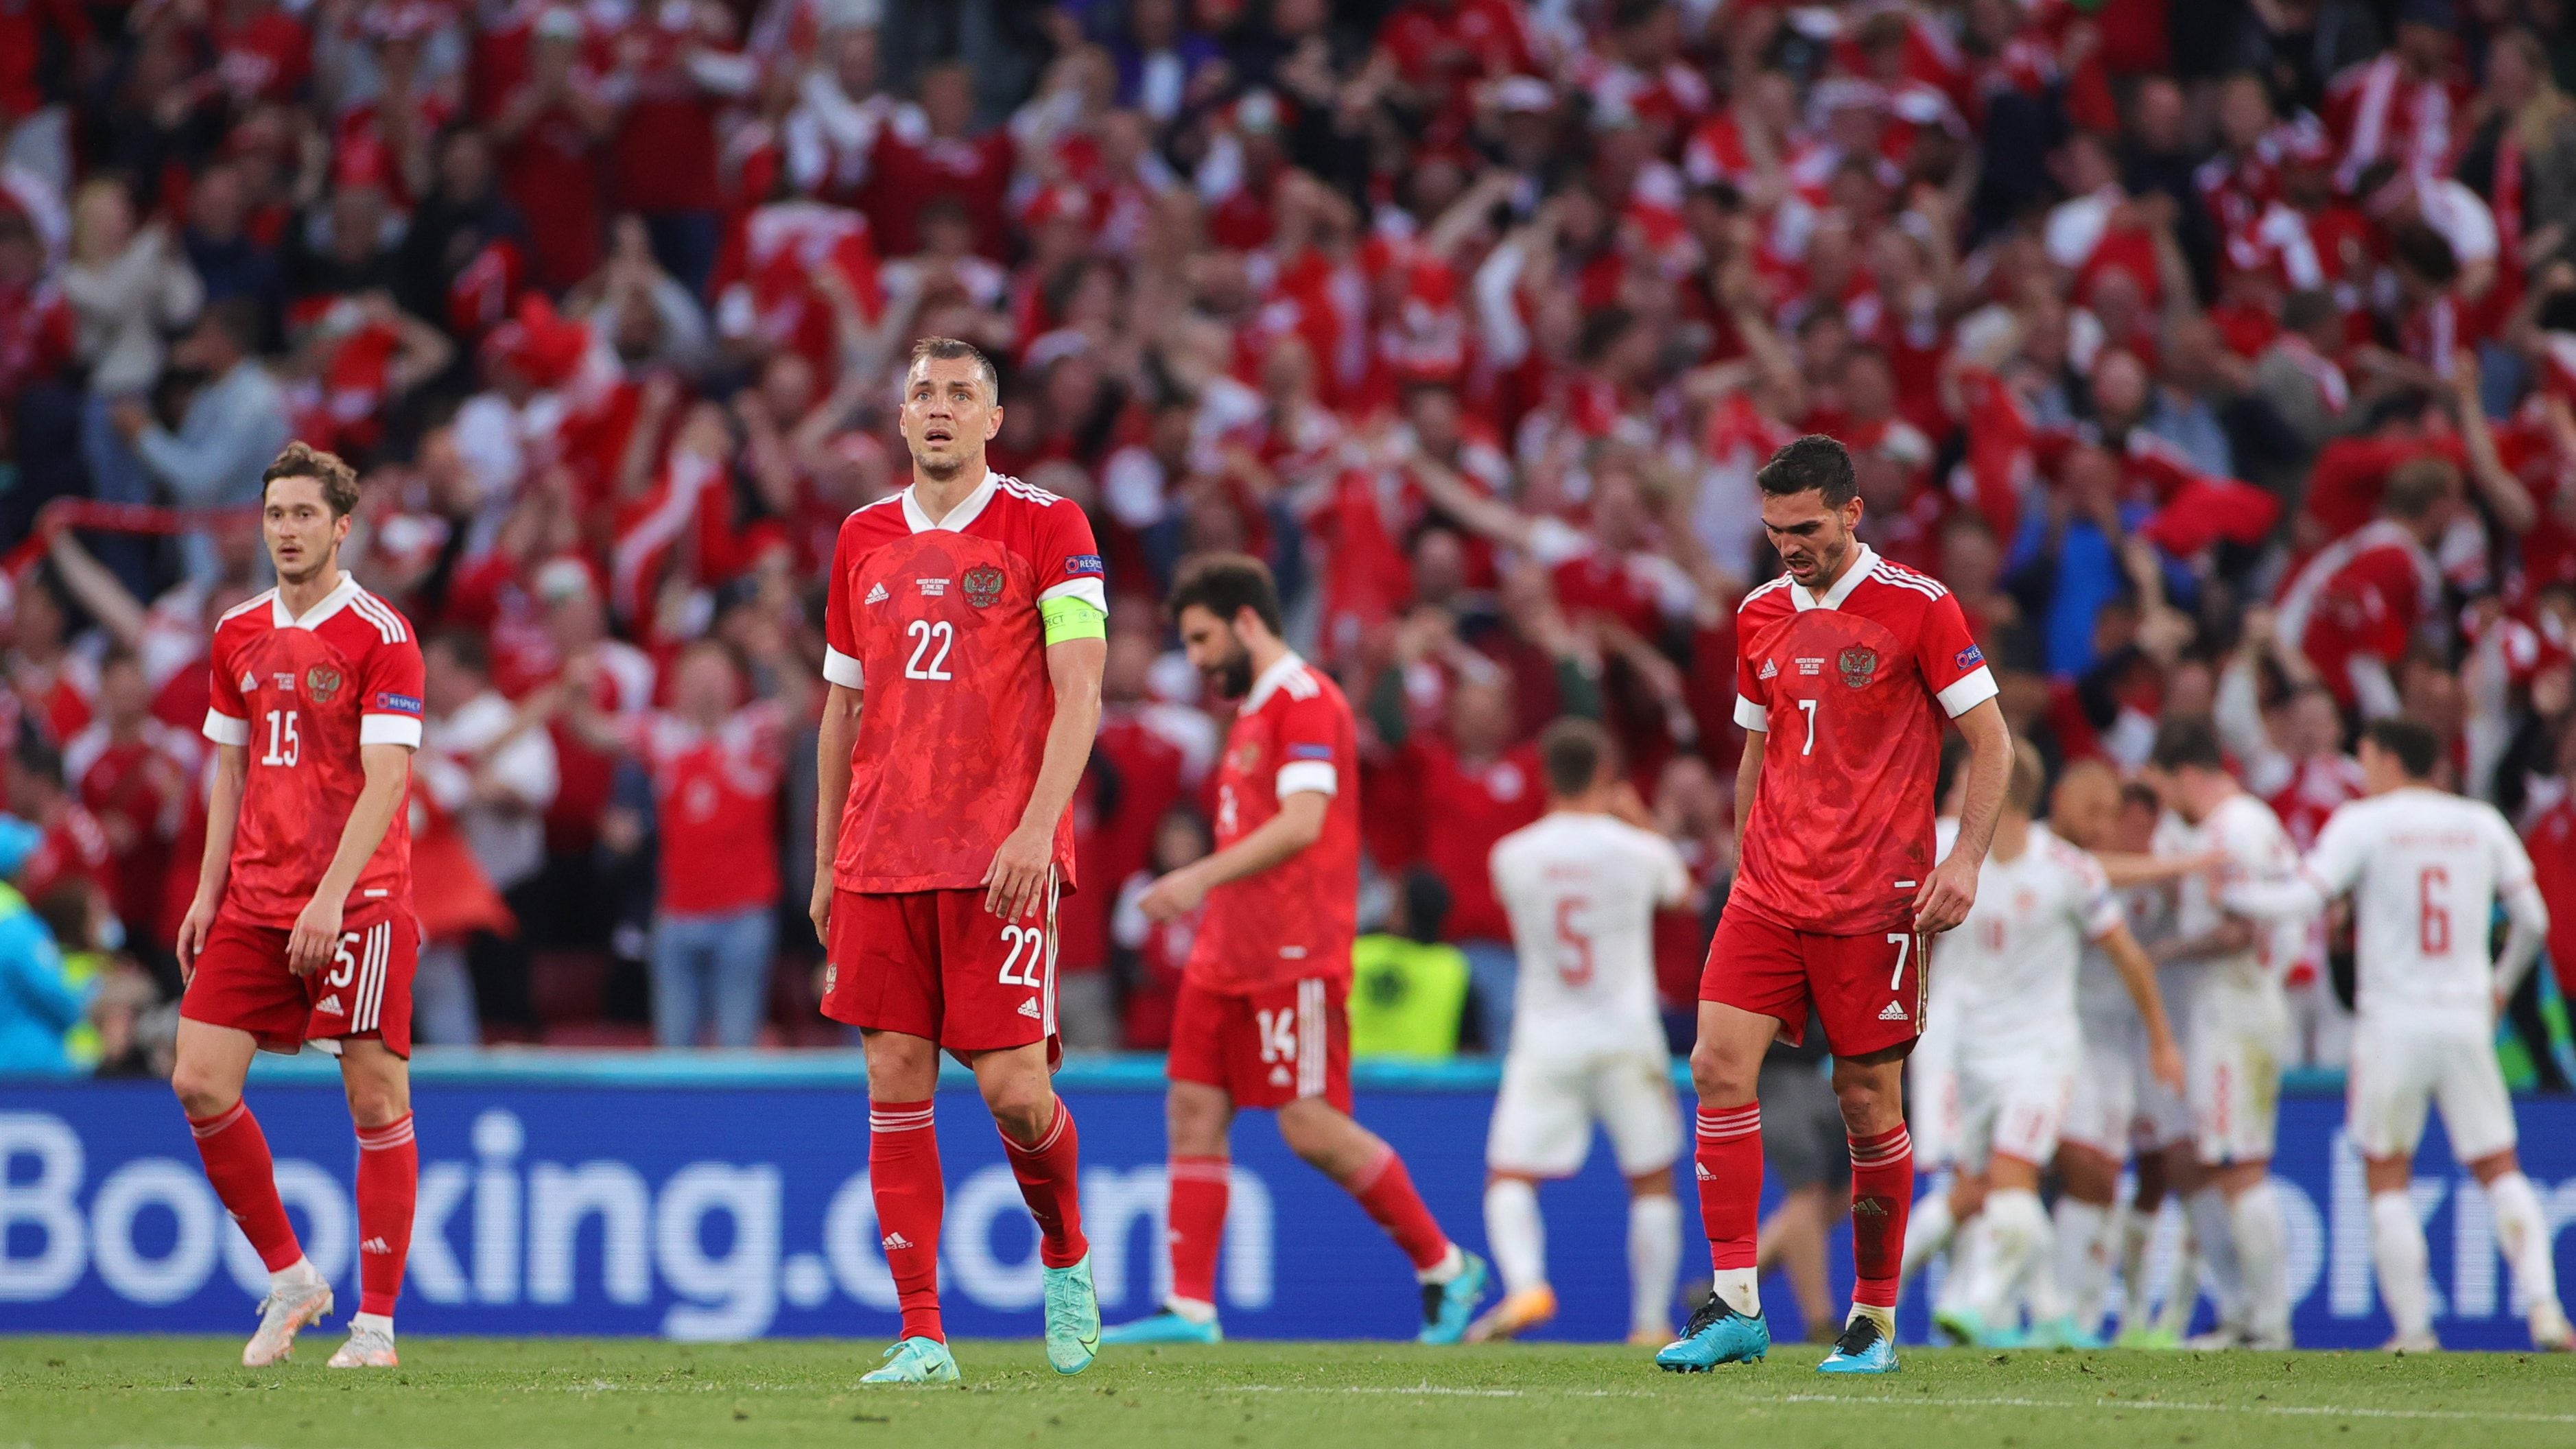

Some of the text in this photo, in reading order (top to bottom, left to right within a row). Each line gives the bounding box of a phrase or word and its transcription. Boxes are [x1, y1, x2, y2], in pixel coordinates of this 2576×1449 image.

[864, 592, 889, 605] adidas
[905, 620, 953, 681] 22
[261, 709, 299, 768] 15
[1798, 699, 1817, 755] 7
[1554, 892, 1594, 988] 5
[2419, 865, 2453, 958] 6
[324, 932, 360, 988] 5
[999, 924, 1043, 988] 22
[1887, 933, 1910, 990] 7
[1017, 1006, 1041, 1020] adidas
[1255, 1006, 1296, 1064] 14
[1878, 1011, 1909, 1020] adidas
